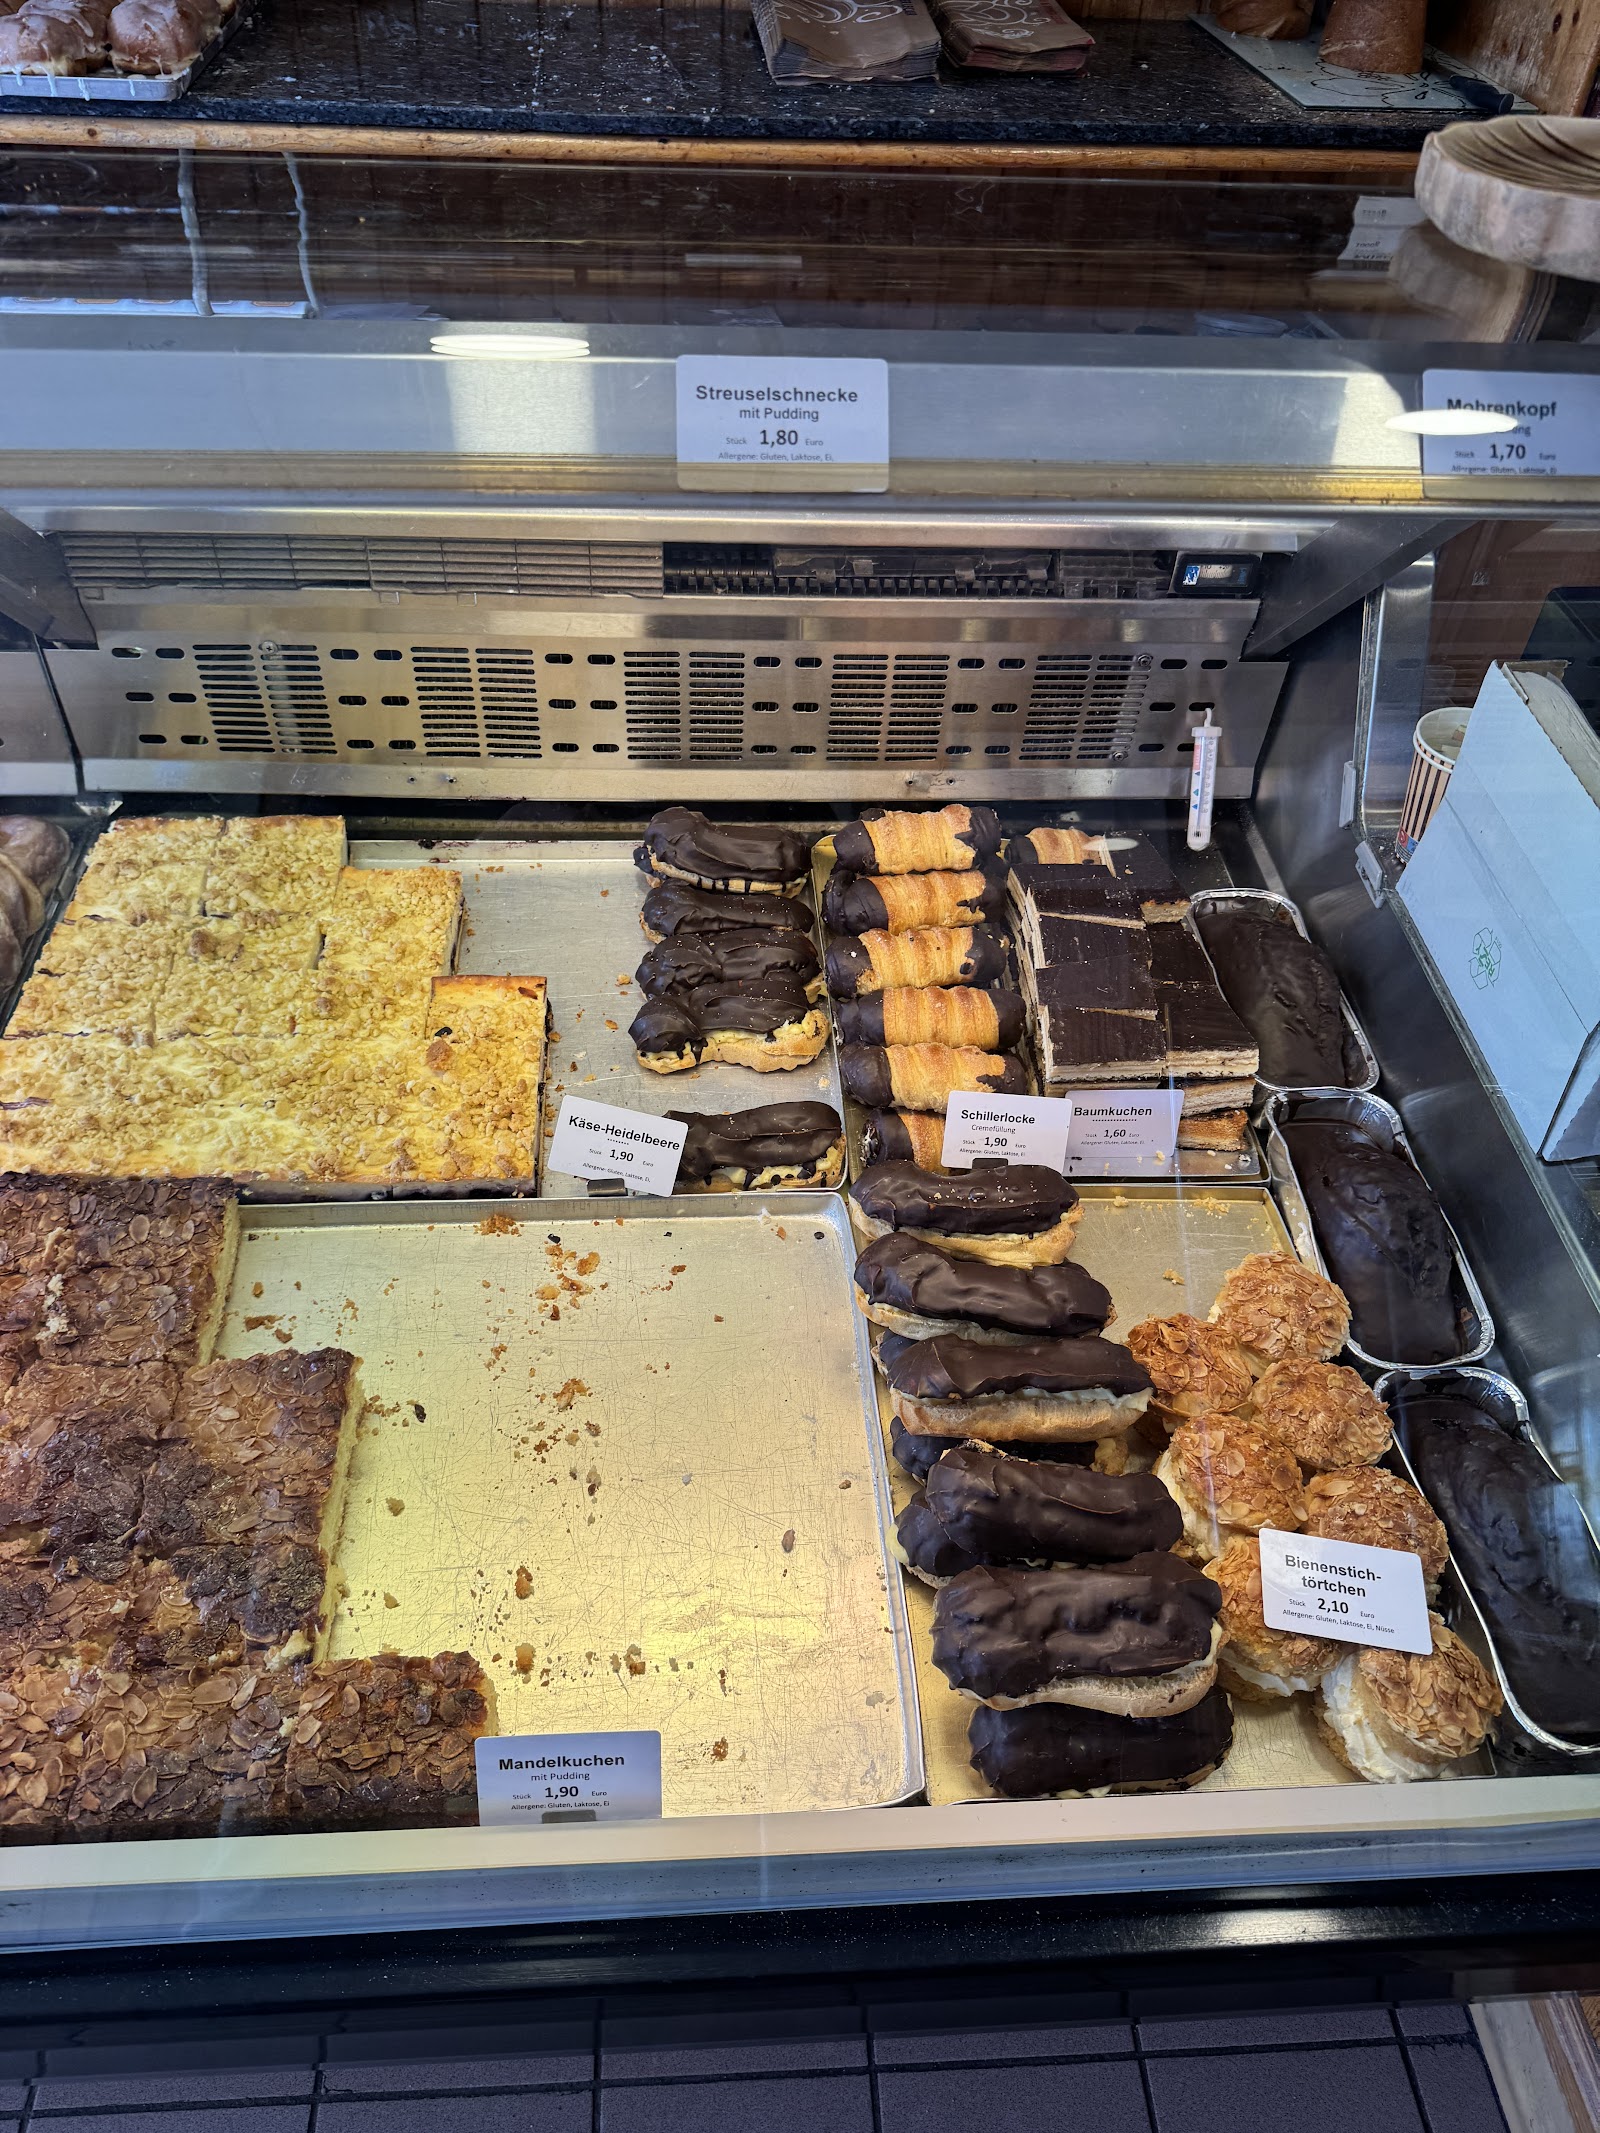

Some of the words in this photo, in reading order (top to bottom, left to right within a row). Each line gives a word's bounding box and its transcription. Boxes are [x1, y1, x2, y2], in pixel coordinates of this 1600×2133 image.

[696, 385, 858, 402] Streuselschnecke
[739, 408, 760, 419] mit
[764, 408, 819, 422] Pudding
[726, 437, 747, 445] Stück
[760, 430, 798, 448] 1,80
[805, 438, 824, 446] Euro
[718, 452, 758, 461] Allergene:
[760, 453, 788, 461] Gluten,
[791, 453, 822, 462] Laktose,
[1490, 443, 1526, 461] 1,70
[961, 1109, 1036, 1125] Schillerlocke
[1074, 1106, 1152, 1118] Baumkuchen
[569, 1115, 680, 1151] Käse-Heidelbeere
[971, 1124, 1016, 1134] Cremefüllung
[1104, 1129, 1126, 1139] 1,60
[984, 1136, 1008, 1148] 1,90
[610, 1149, 634, 1162] 1,90
[1285, 1554, 1382, 1582] Bienenstich-
[1302, 1575, 1366, 1597] törtchen
[1289, 1598, 1306, 1607] Stück
[1317, 1598, 1349, 1614] 2,10
[1360, 1611, 1375, 1619] Euro
[1283, 1609, 1315, 1620] Allergene:
[1316, 1615, 1338, 1625] Gluten,
[1340, 1619, 1366, 1630] Laktose,
[1375, 1625, 1395, 1634] Nüsse
[499, 1755, 625, 1771] Mandelkuchen
[531, 1773, 547, 1781] mit
[550, 1772, 590, 1781] Pudding
[545, 1786, 579, 1800] 1,90
